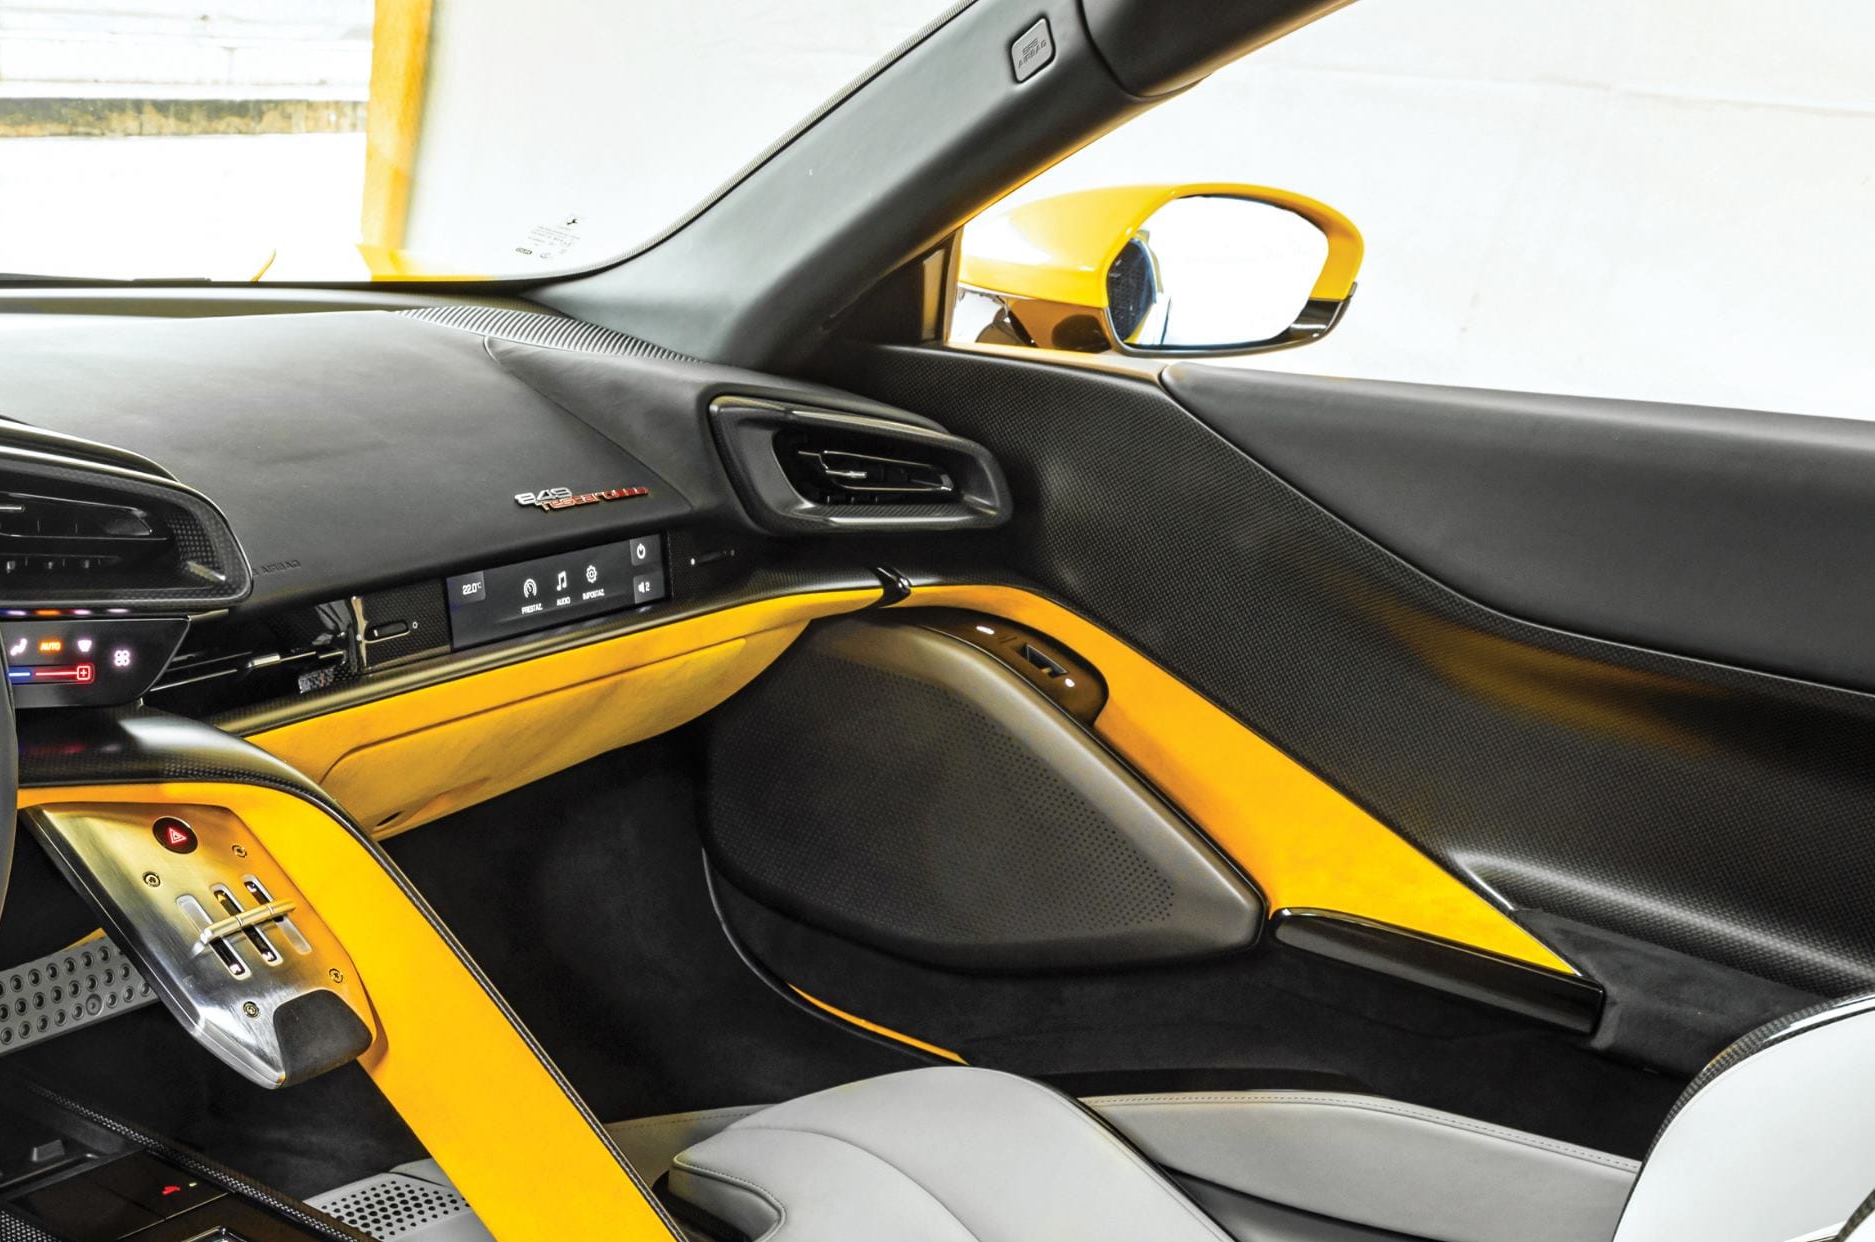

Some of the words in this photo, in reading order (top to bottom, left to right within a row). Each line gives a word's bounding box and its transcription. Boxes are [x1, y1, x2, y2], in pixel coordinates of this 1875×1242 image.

[514, 486, 573, 506] 849
[555, 596, 572, 607] AUDIO
[39, 641, 63, 652] AUTO
